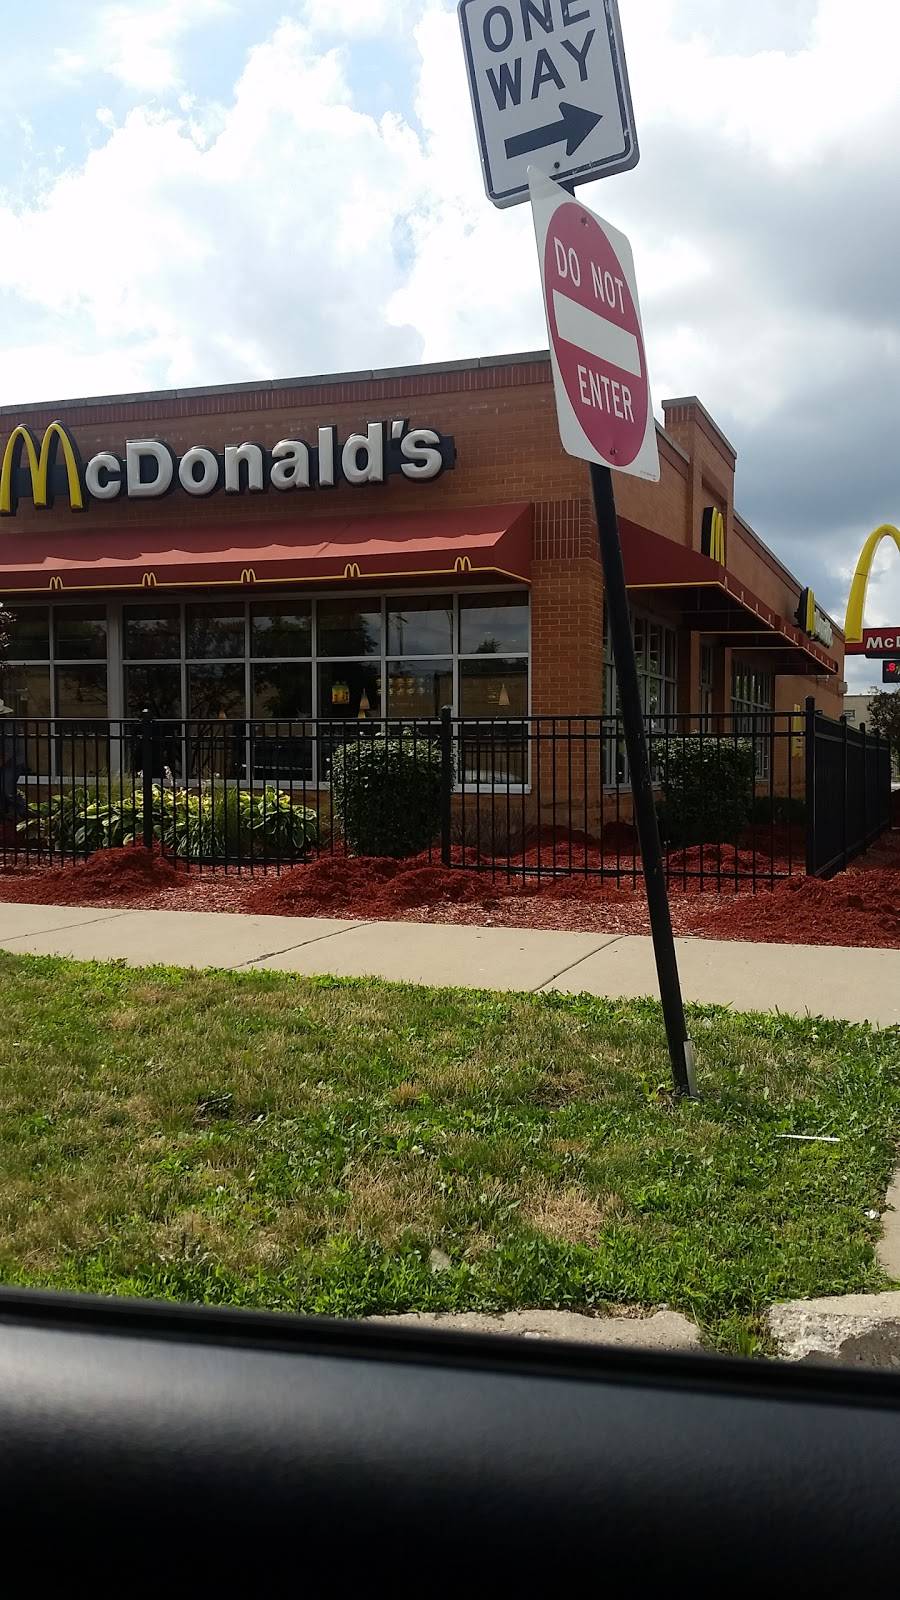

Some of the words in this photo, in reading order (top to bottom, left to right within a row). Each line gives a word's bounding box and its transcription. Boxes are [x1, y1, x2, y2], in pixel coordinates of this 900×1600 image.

[483, 0, 591, 52] ONE
[485, 28, 596, 111] WAY
[553, 236, 581, 287] DO
[590, 261, 625, 315] NOT
[577, 364, 635, 424] ENTER
[0, 418, 443, 512] McDonald's
